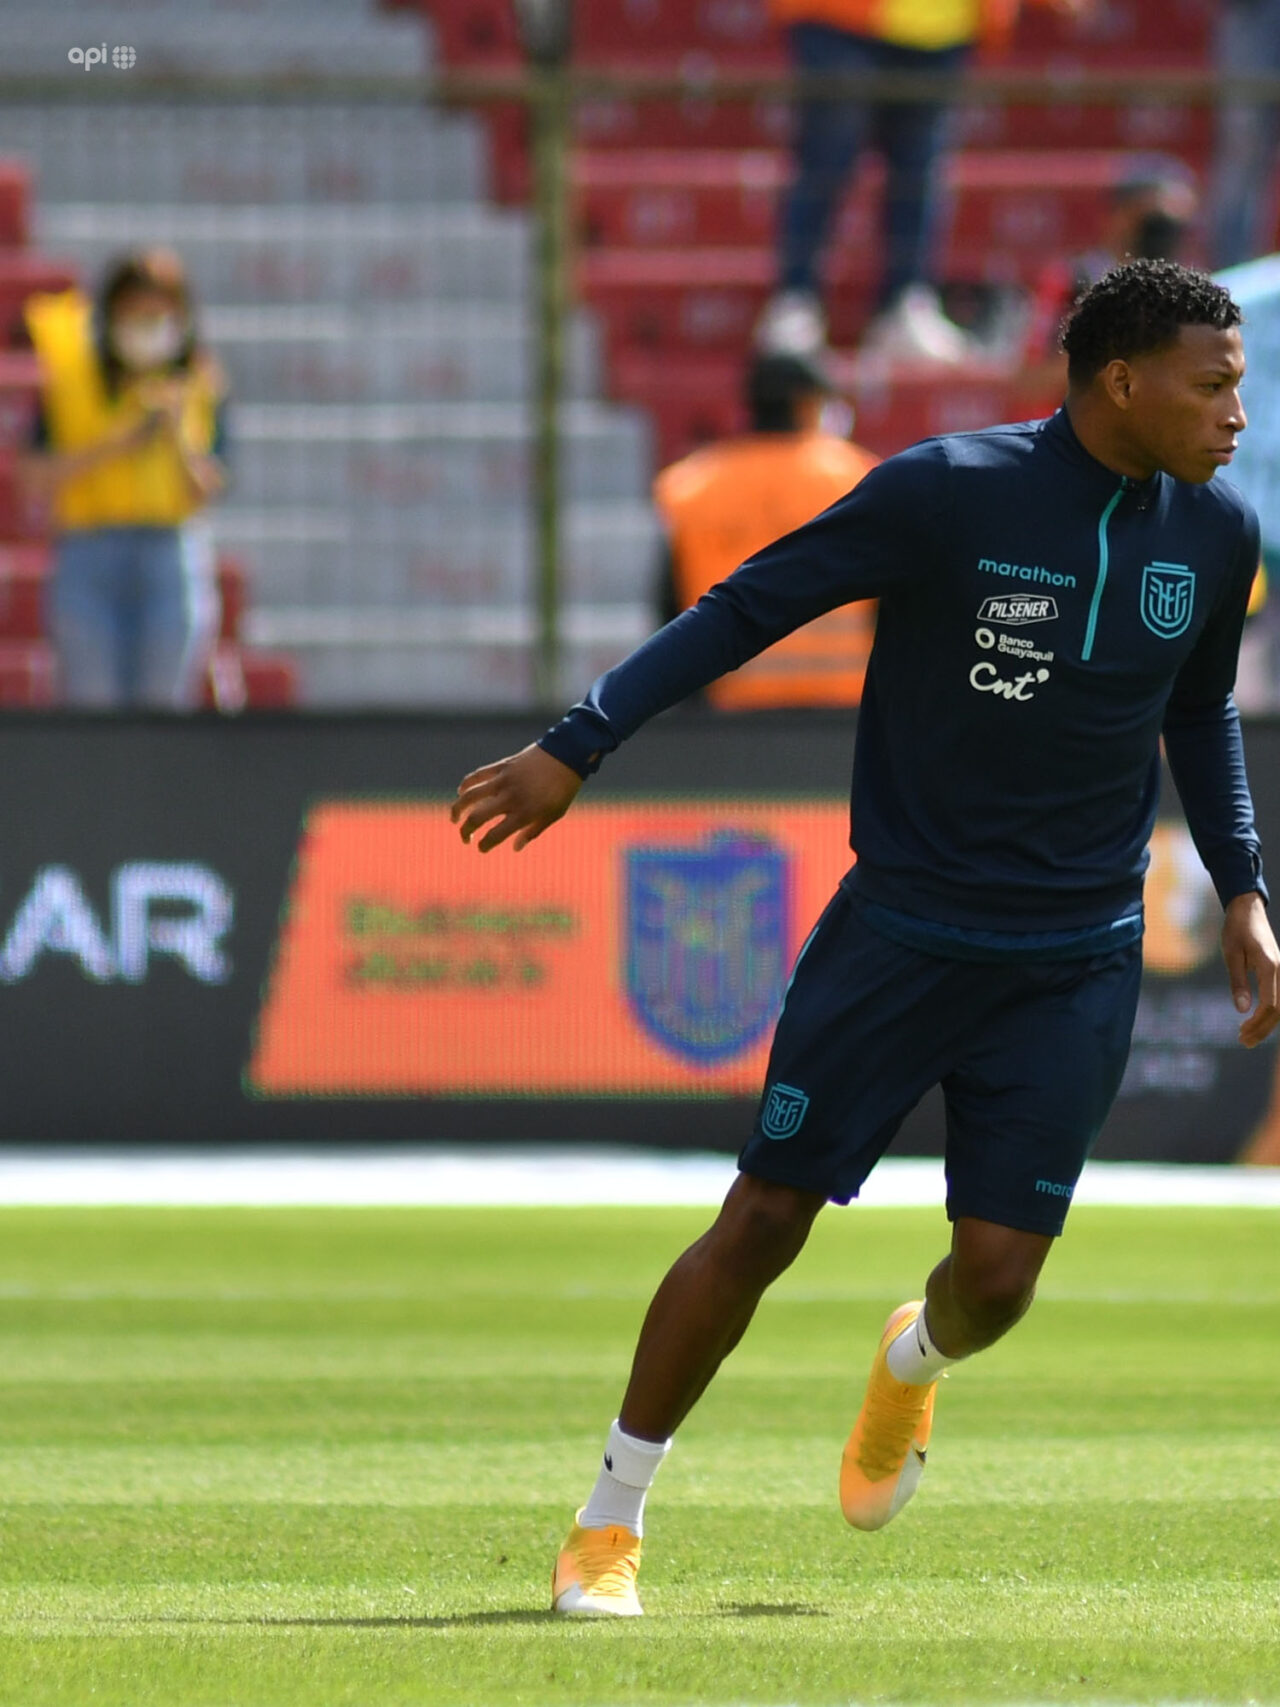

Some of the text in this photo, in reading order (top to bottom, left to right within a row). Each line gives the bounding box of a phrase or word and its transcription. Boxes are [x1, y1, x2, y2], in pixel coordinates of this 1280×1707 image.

[977, 558, 1076, 588] marathon
[987, 600, 1050, 618] PILSENER
[999, 634, 1034, 649] Banco
[997, 643, 1054, 662] Guayaquil
[0, 862, 235, 984] AR
